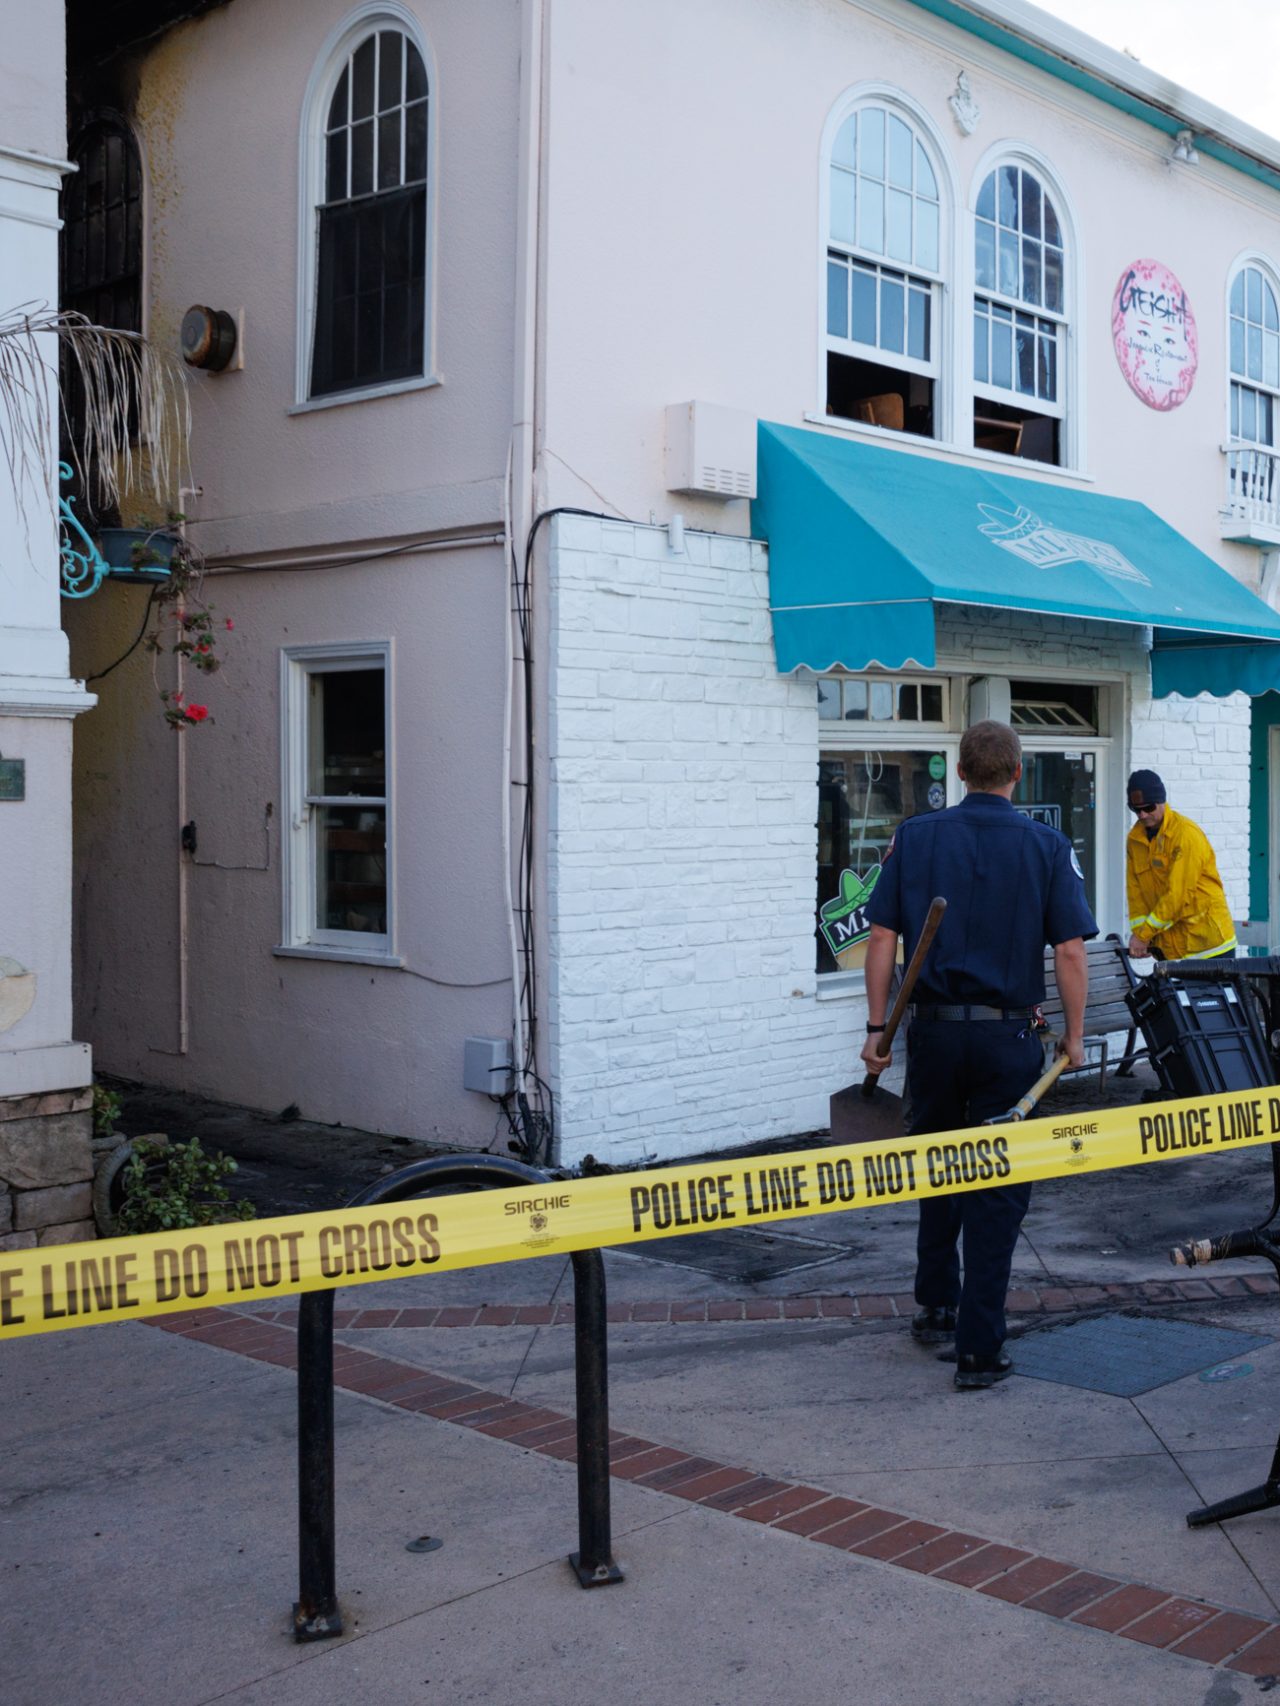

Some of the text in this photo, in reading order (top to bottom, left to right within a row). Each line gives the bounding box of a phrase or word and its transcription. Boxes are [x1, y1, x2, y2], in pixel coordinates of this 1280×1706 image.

[1052, 1122, 1099, 1140] SIRCHIE
[1139, 1107, 1212, 1155] POLICE
[1217, 1100, 1264, 1142] LINE
[504, 1195, 570, 1216] SIRCHIE
[630, 1137, 1011, 1232] POLICE LINE DO NOT CROSS
[42, 1252, 140, 1319] LINE
[154, 1244, 209, 1303] DO
[224, 1231, 304, 1292] NOT
[318, 1213, 441, 1278] CROSS
